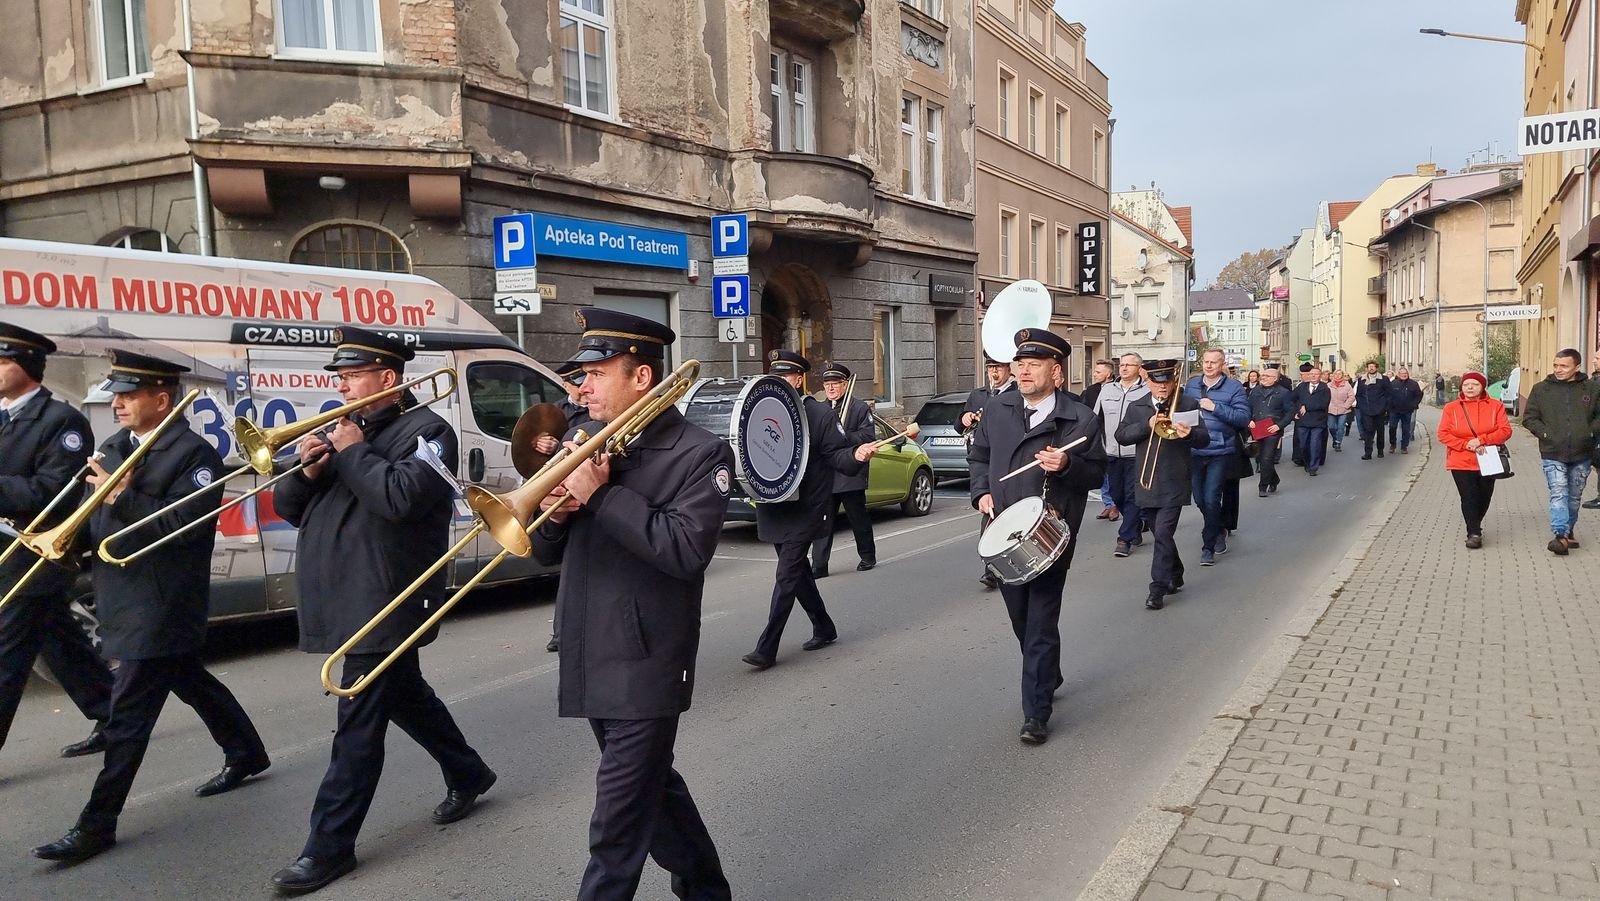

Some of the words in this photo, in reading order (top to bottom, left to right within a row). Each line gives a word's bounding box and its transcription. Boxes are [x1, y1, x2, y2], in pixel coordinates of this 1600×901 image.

[545, 224, 595, 246] Apteka
[599, 231, 625, 250] Pod
[628, 235, 679, 256] Teatrem
[1083, 226, 1096, 293] OPTYK
[3, 270, 98, 309] DOM
[112, 277, 322, 321] MUROWANY
[333, 286, 398, 325] 108
[1490, 309, 1538, 317] NOTARIUSZ
[236, 373, 283, 392] STAN
[744, 383, 773, 411] ORKIESTRA
[764, 425, 781, 443] PGE
